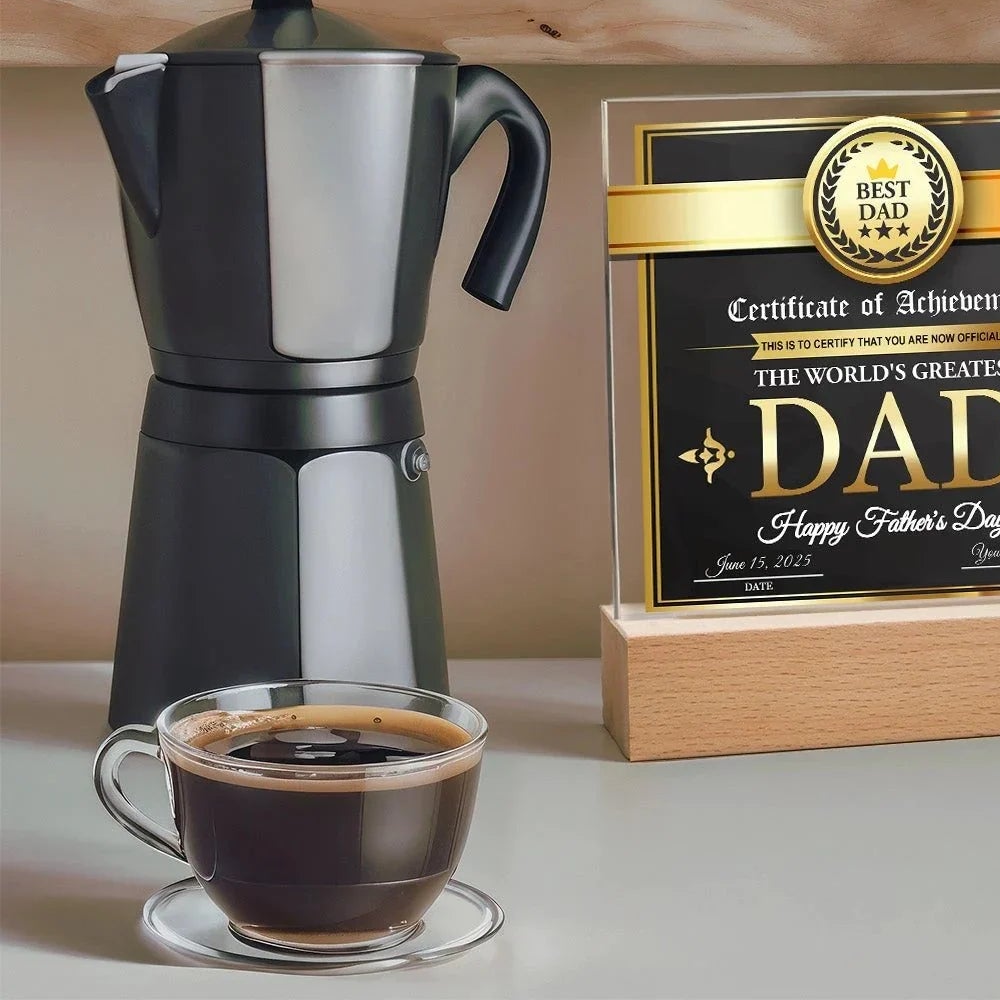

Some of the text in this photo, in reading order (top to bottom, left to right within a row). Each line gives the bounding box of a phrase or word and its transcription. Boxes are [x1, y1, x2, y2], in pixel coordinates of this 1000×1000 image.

[856, 180, 911, 200] BEST
[859, 202, 909, 221] DAD
[727, 296, 849, 322] Certificate
[861, 293, 884, 316] of
[761, 340, 784, 351] THIS
[785, 339, 796, 350] IS
[797, 339, 811, 350] TO
[814, 337, 856, 349] CERTIFY
[857, 336, 882, 347] THAT
[885, 335, 906, 346] YOU
[907, 334, 929, 345] ARE
[931, 333, 955, 344] NOW
[754, 368, 801, 387] THE
[804, 363, 906, 384] WORLD'S
[757, 508, 849, 546] Happy
[855, 505, 948, 539] Father's
[705, 552, 812, 579] June 15, 2025
[745, 582, 774, 592] DATE
